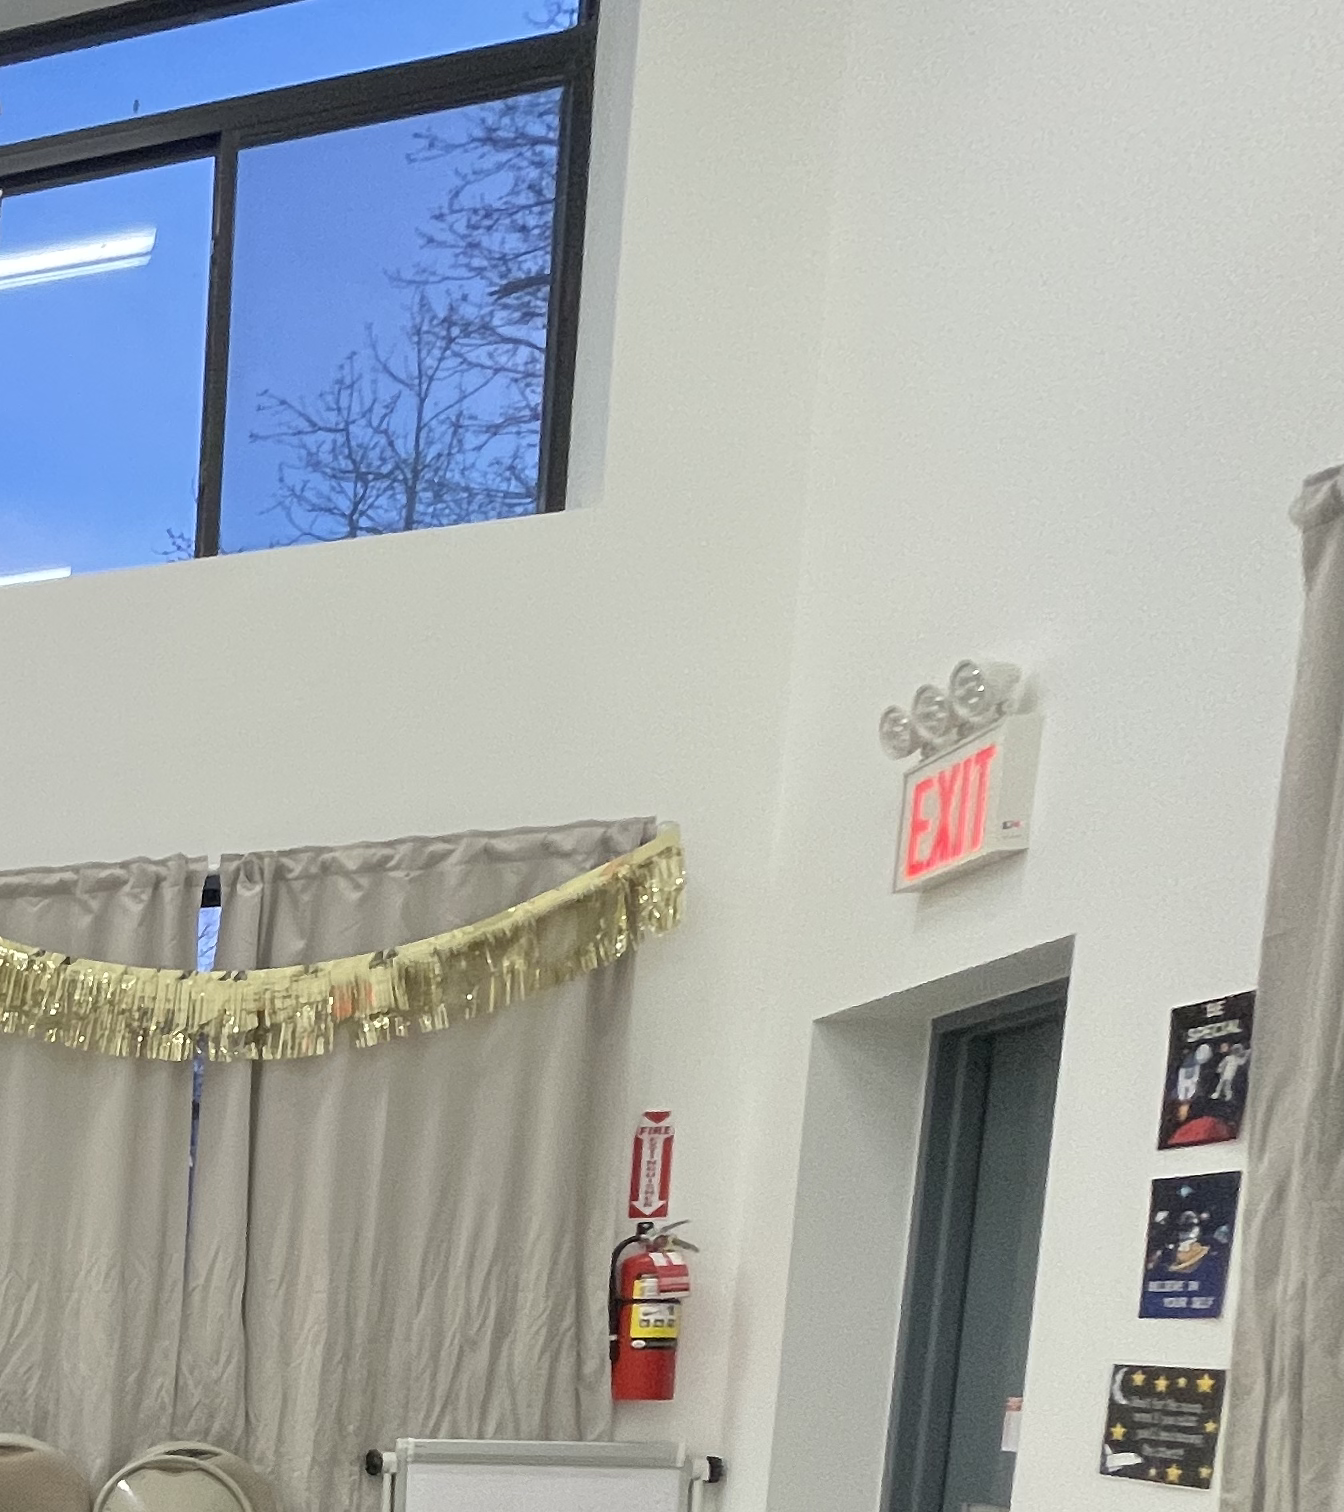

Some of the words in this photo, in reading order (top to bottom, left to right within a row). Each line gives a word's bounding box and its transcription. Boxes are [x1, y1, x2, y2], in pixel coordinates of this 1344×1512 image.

[906, 744, 997, 878] EXIT
[1187, 1019, 1243, 1042] SPECIAL
[639, 1126, 672, 1135] FIRE
